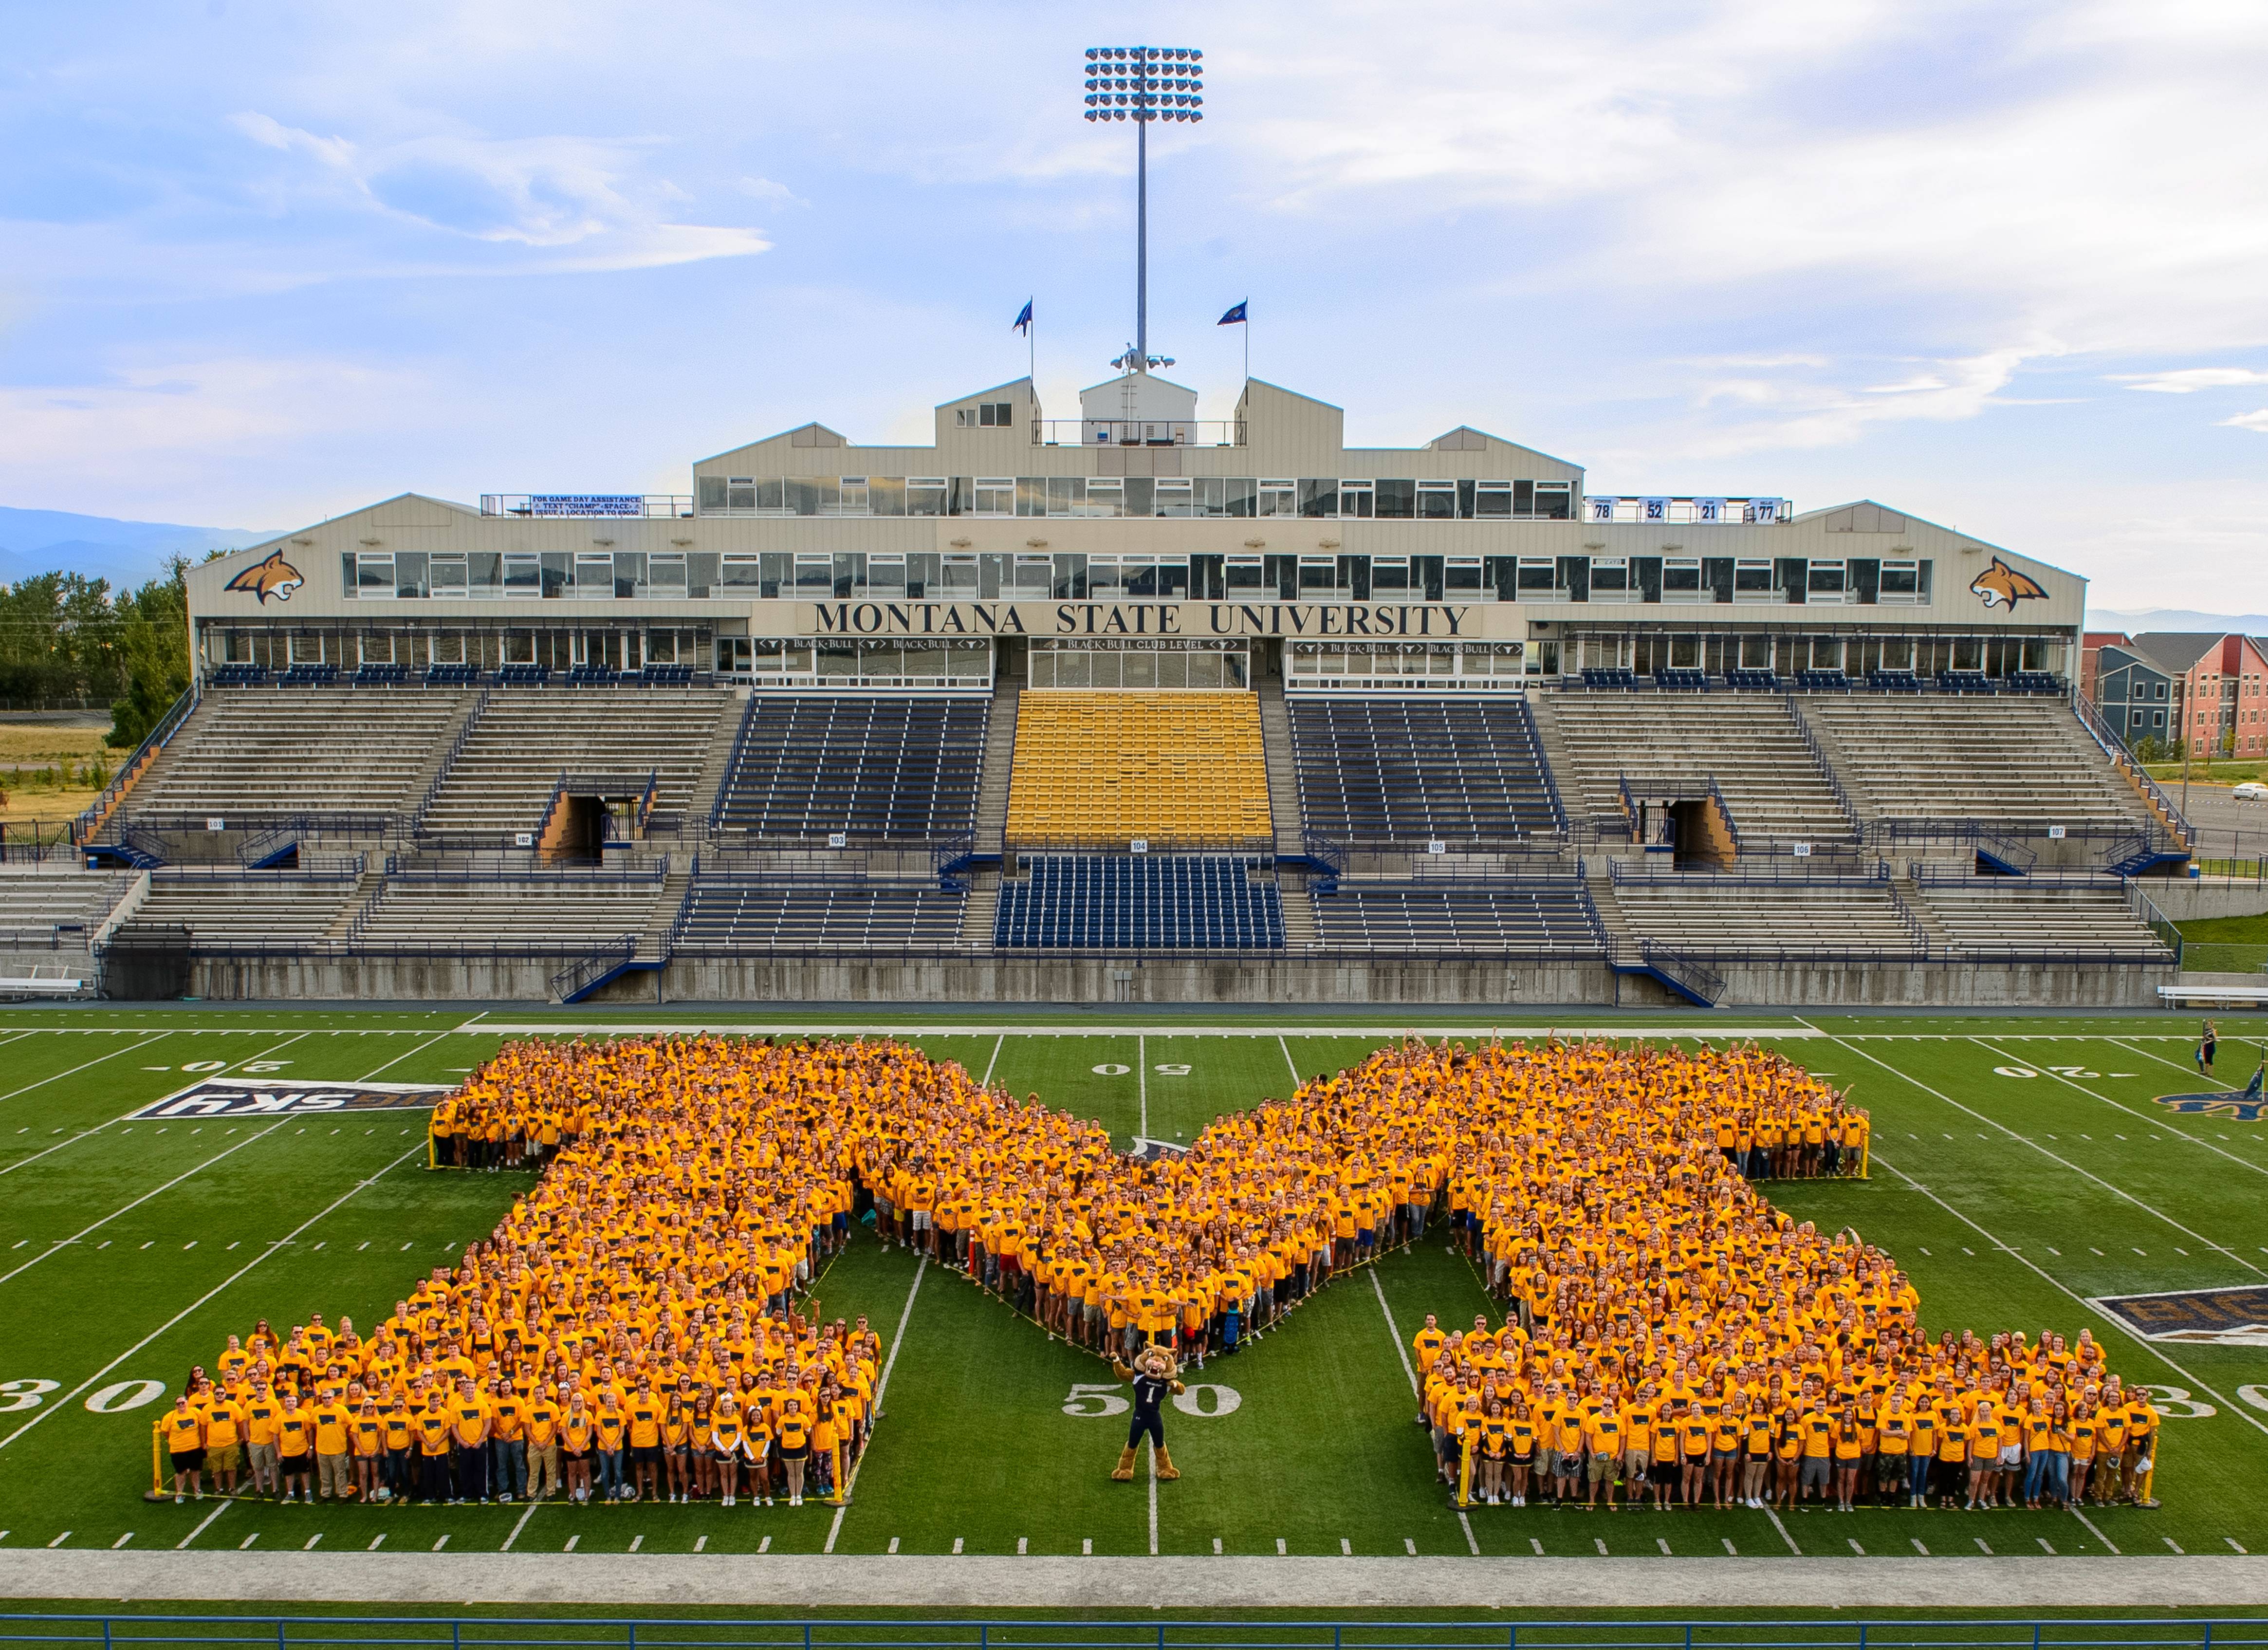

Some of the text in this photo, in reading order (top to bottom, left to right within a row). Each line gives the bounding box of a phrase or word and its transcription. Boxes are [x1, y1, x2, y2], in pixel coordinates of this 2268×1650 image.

[1595, 504, 1609, 518] 78
[1647, 504, 1662, 519] 52
[1702, 505, 1715, 519] 21
[1759, 506, 1774, 520] 77
[813, 604, 1470, 635] MONTANA STATE UNIVERSITY
[1137, 640, 1166, 649] CLUB
[1170, 641, 1203, 650] LEVEL
[1145, 1386, 1155, 1403] 1
